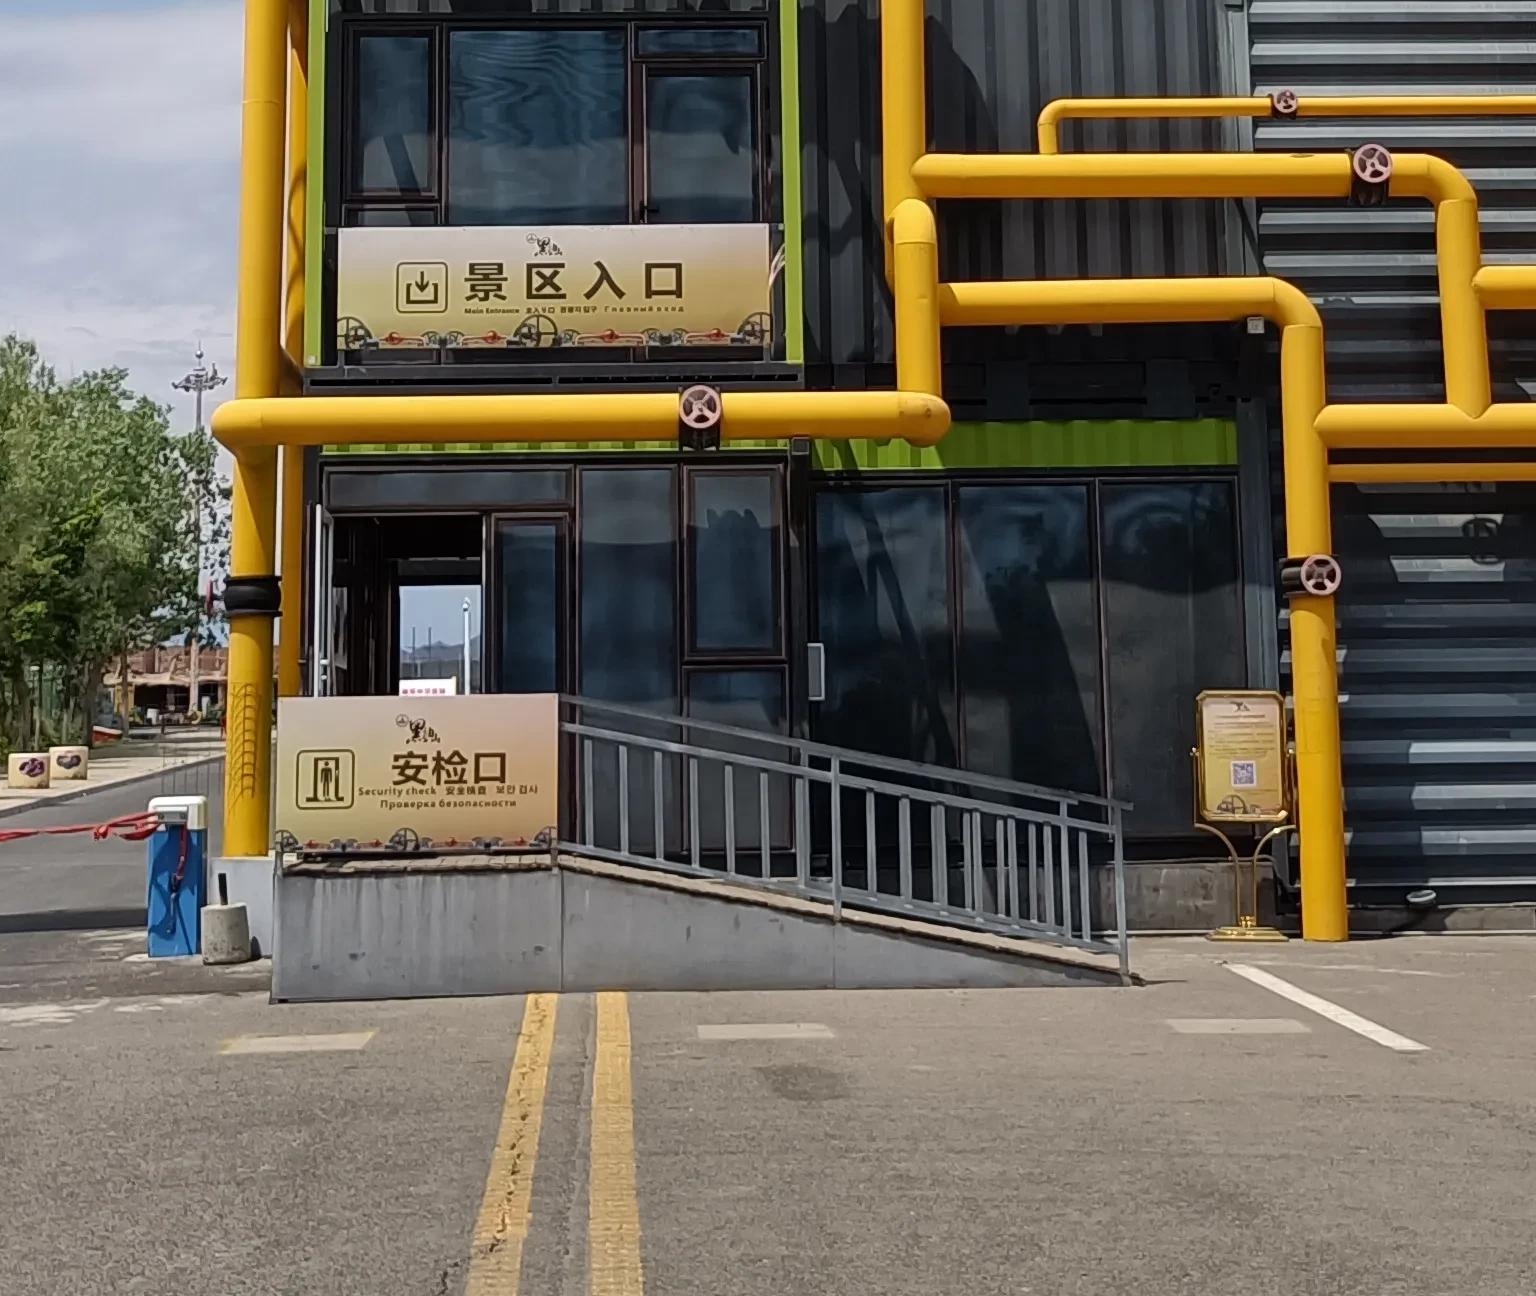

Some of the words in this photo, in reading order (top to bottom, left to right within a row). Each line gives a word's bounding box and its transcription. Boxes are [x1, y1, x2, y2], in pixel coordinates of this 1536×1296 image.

[464, 261, 683, 302] 景区入口
[392, 750, 506, 785] 安检口
[358, 786, 403, 797] Security
[406, 786, 437, 795] check
[380, 799, 436, 811] Проверка
[438, 798, 517, 809] безопасности
